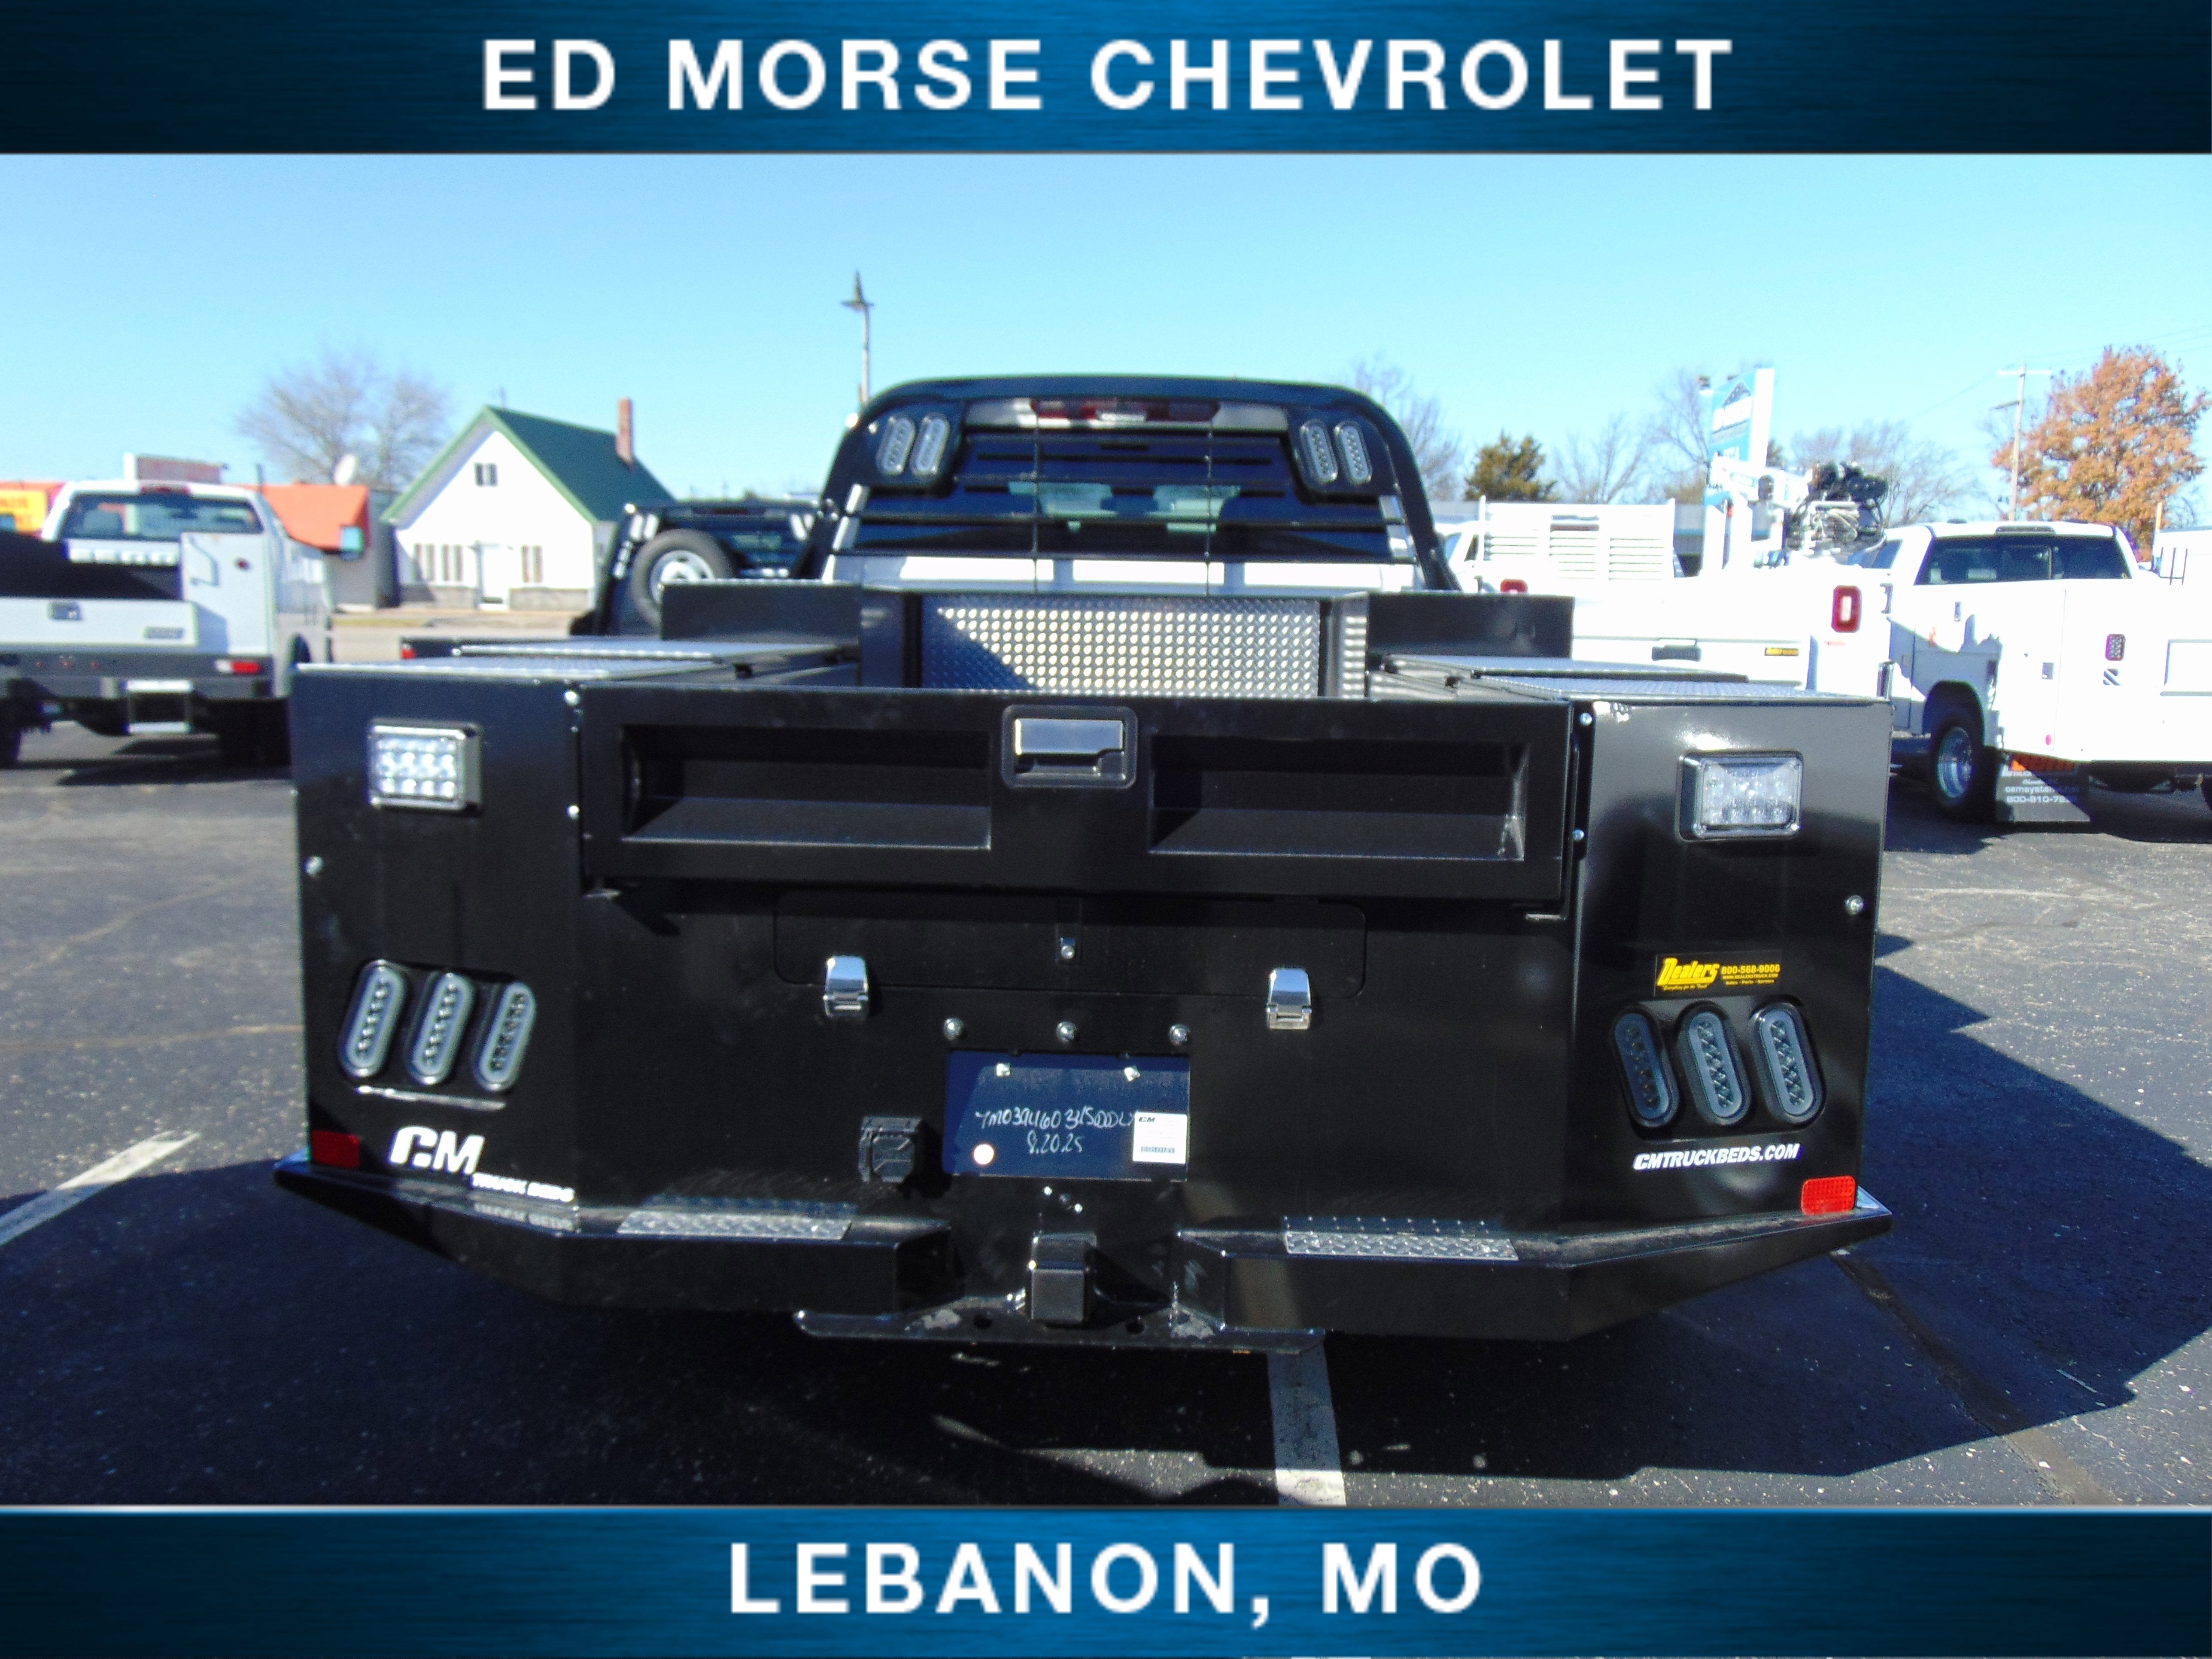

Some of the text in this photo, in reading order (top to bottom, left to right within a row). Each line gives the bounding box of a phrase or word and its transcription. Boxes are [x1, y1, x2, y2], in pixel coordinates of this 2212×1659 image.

[1657, 957, 1720, 986] Dealers
[389, 1125, 486, 1175] CM
[1633, 1142, 1800, 1170] CMTRUCKBEDS.COM
